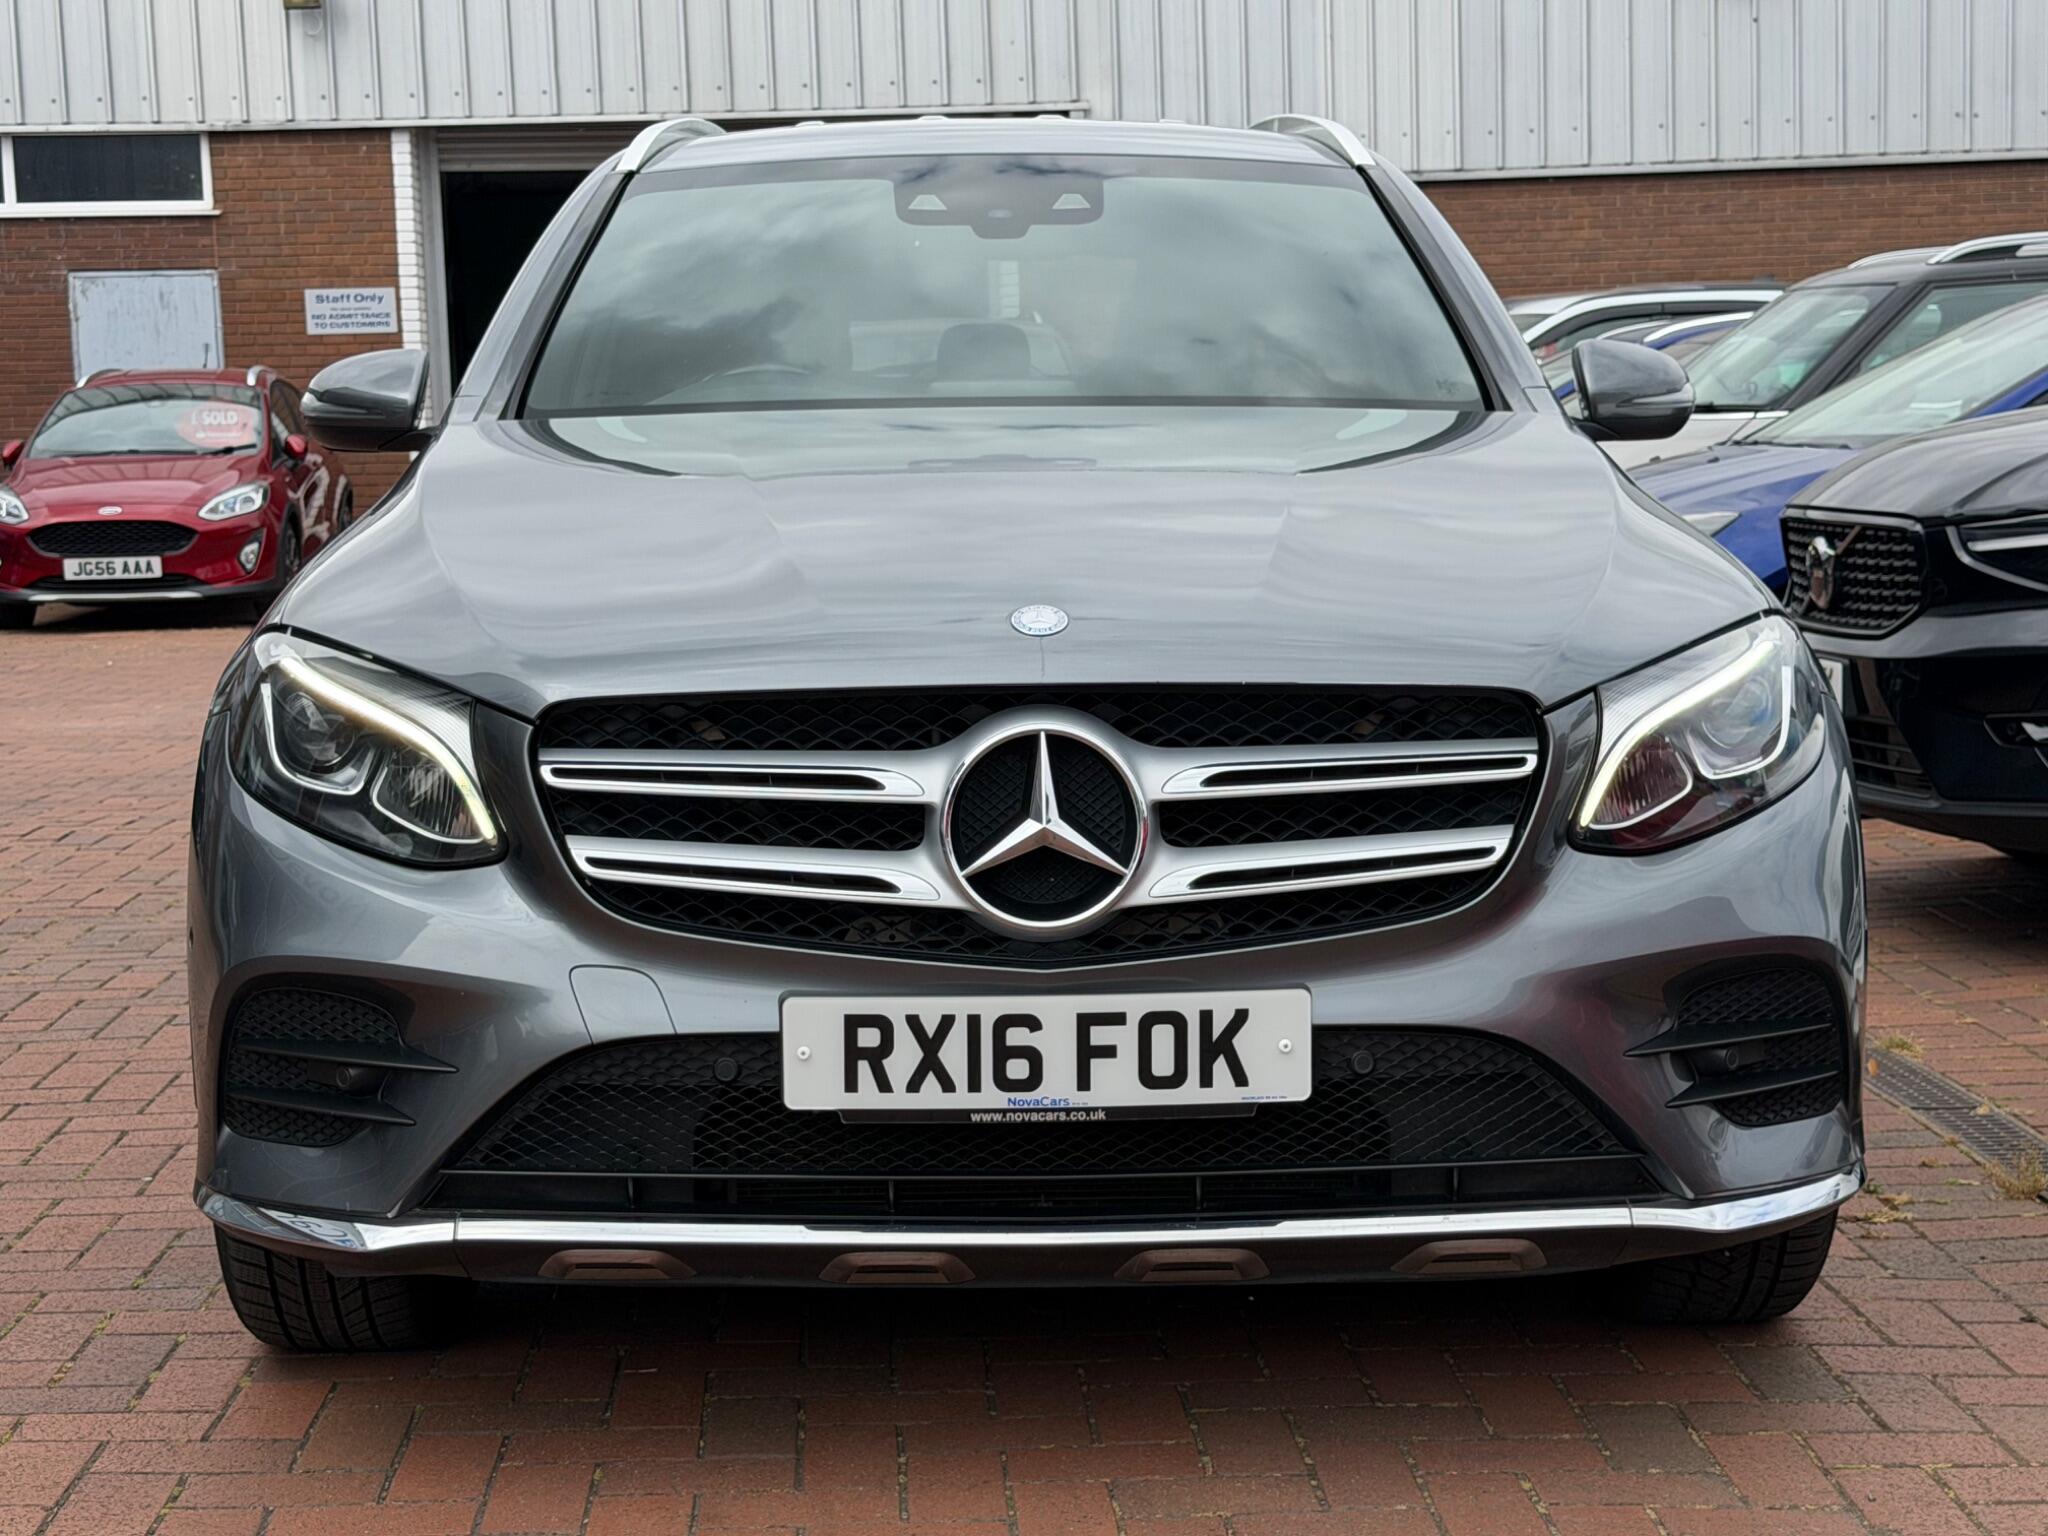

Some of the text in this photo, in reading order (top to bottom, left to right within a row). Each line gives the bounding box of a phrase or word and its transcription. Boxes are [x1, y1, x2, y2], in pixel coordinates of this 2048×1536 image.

[315, 293, 385, 304] Staff Only
[202, 409, 239, 426] SOLD
[73, 560, 154, 577] JG56 AAA
[843, 1008, 1250, 1094] RX16 FOK
[1007, 1096, 1071, 1107] NovaCars
[970, 1109, 1107, 1122] www.novacars.co.uk
